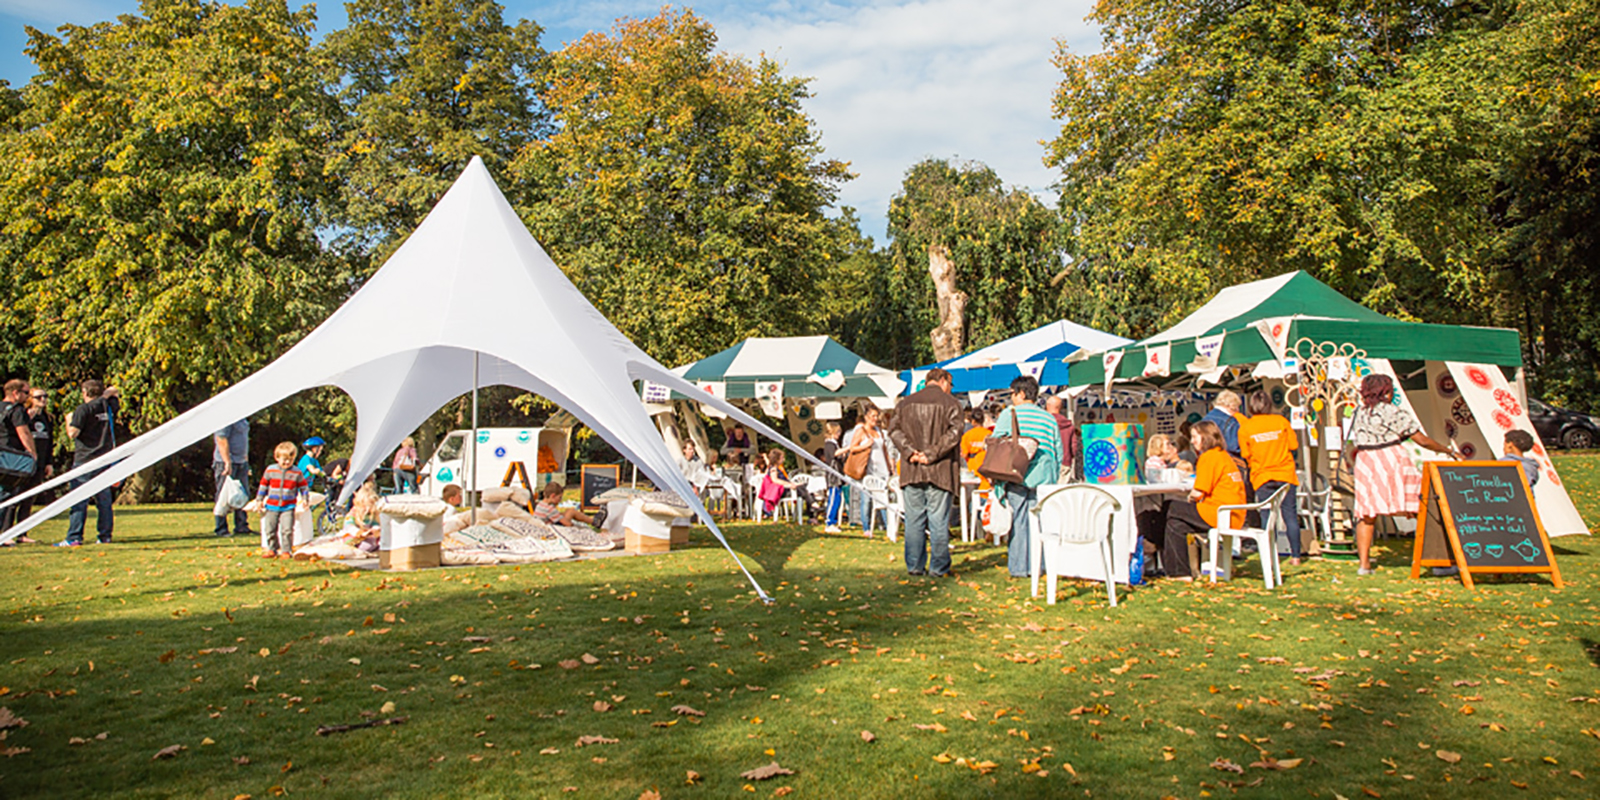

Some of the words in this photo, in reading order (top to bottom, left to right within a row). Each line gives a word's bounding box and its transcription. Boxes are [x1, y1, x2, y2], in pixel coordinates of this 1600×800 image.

[1444, 471, 1463, 482] The
[1465, 474, 1515, 499] Travelling
[1458, 489, 1480, 504] Tea
[1482, 490, 1509, 503] Room
